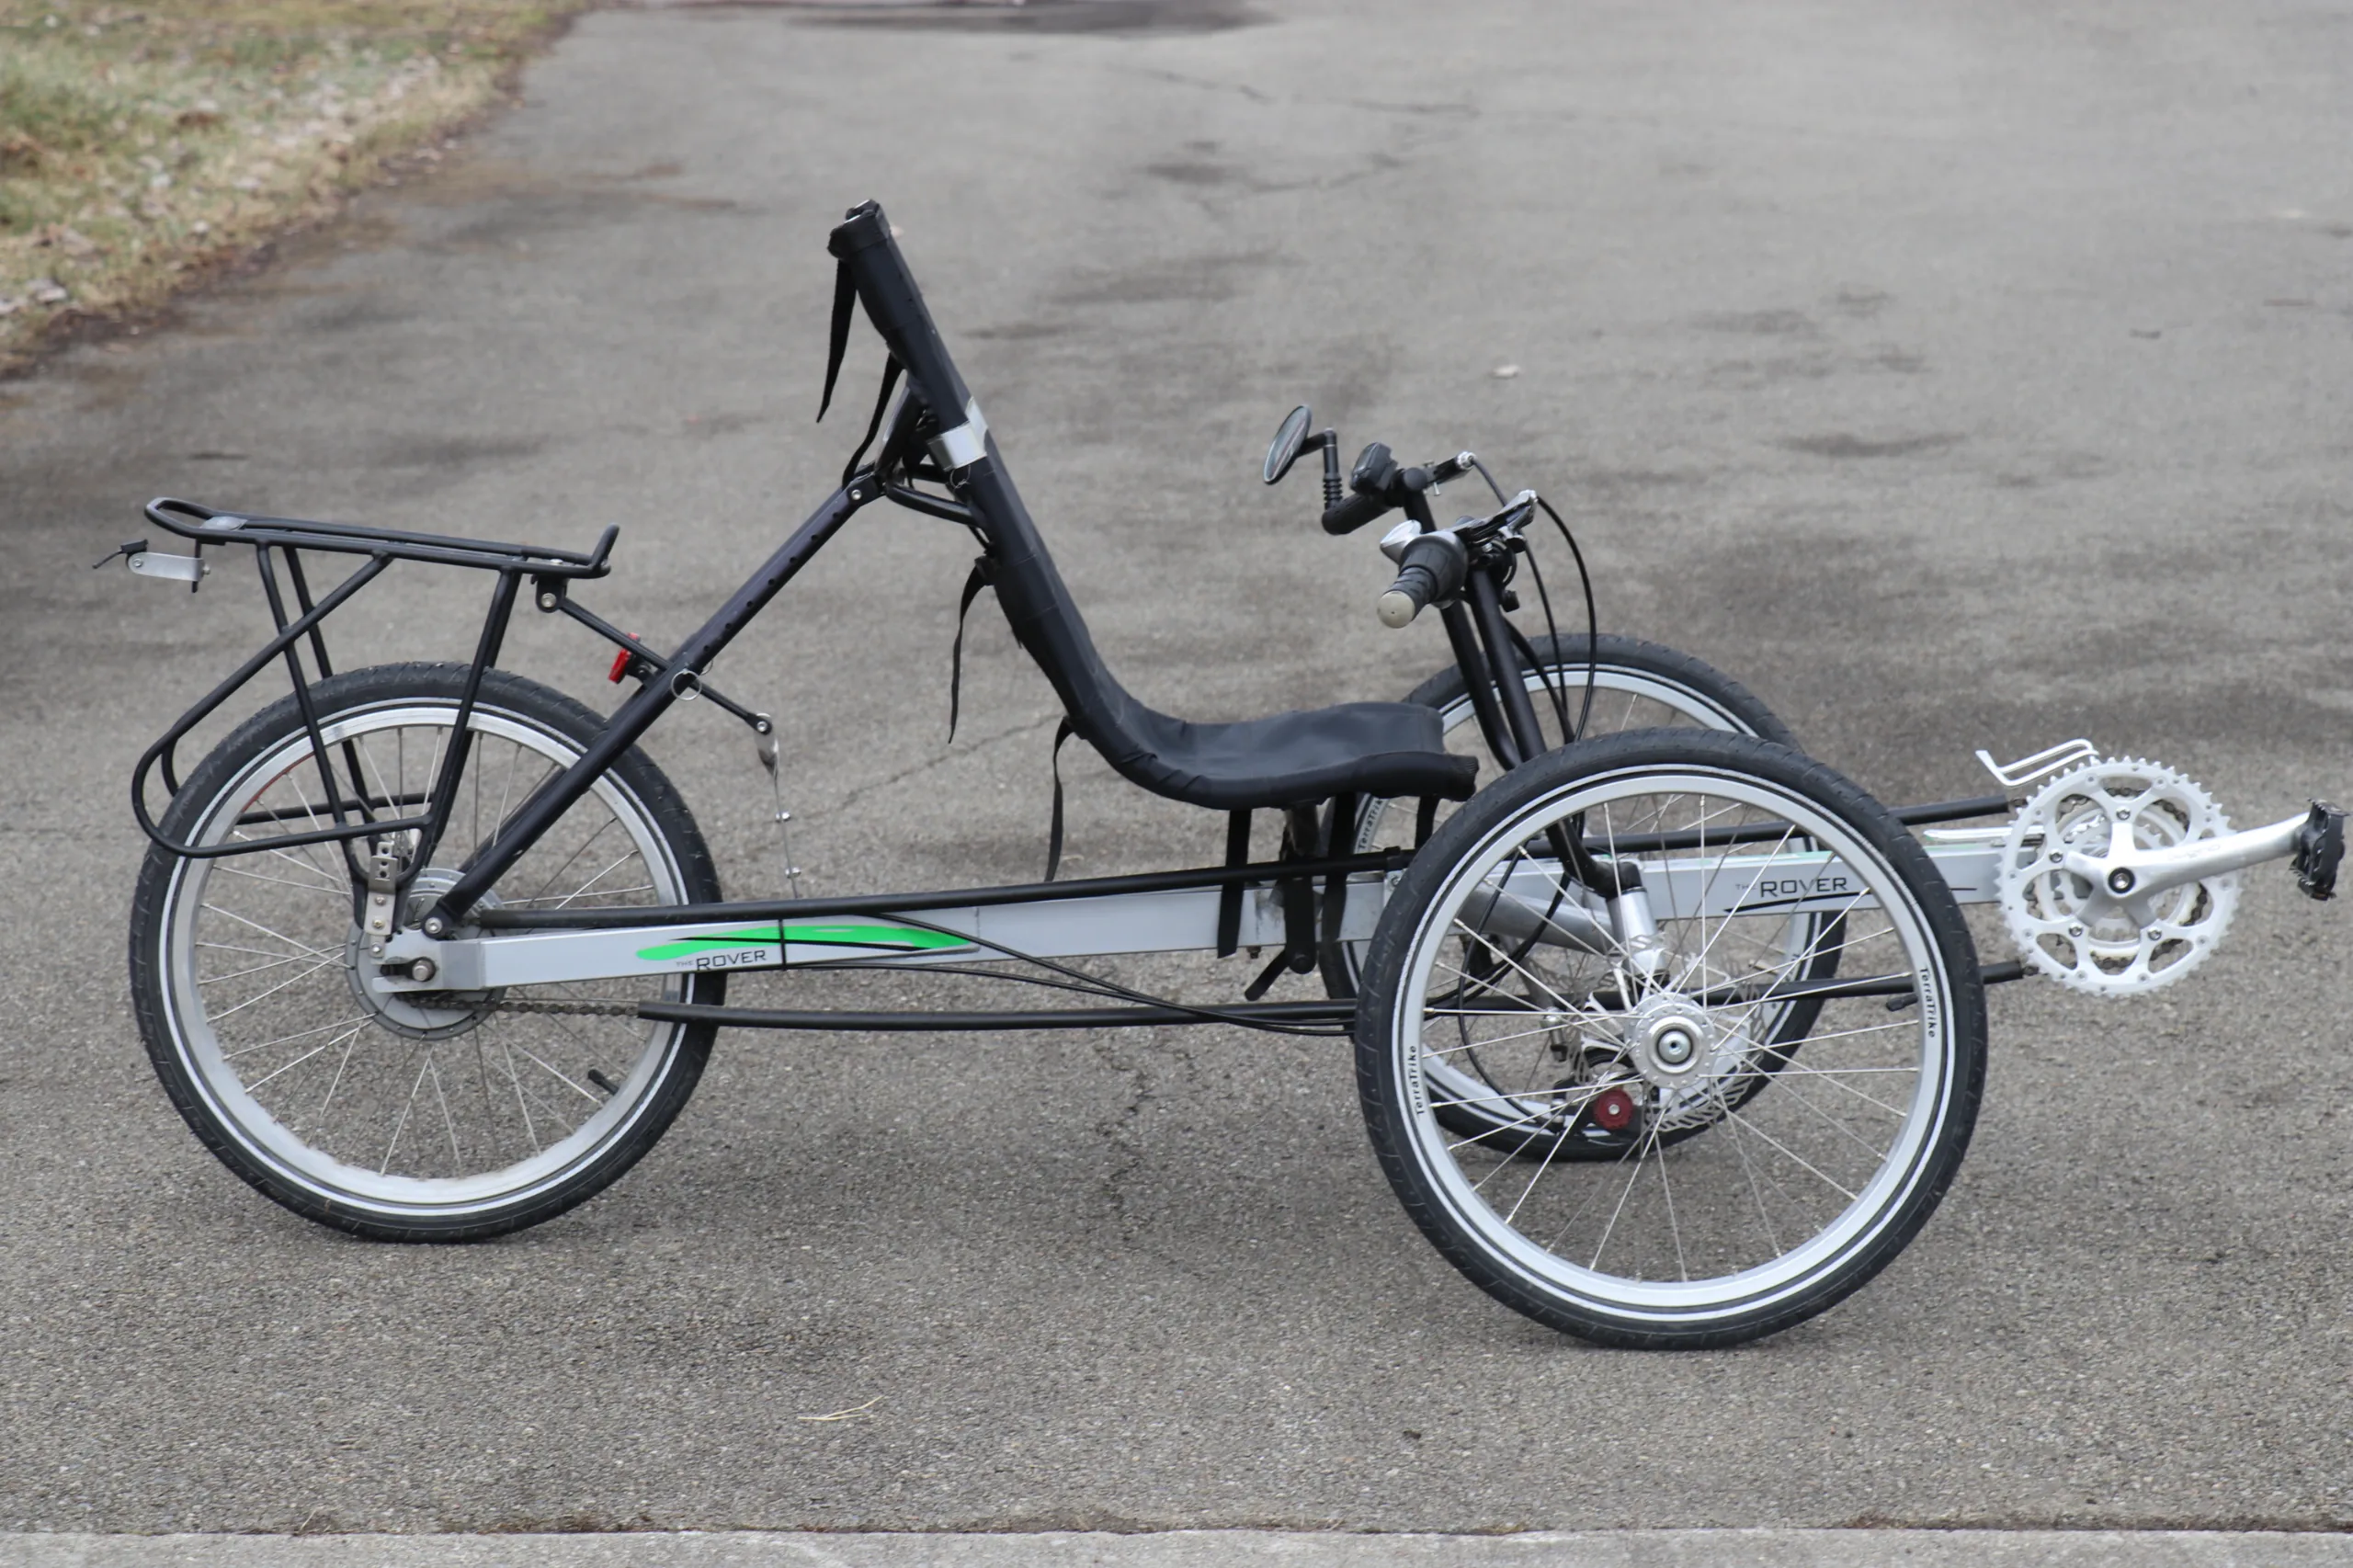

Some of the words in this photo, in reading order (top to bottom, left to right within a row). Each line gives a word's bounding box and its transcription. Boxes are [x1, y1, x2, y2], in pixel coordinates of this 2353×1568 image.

[1358, 799, 1383, 849] TerraTrik
[1760, 877, 1847, 898] ROVER
[696, 949, 767, 971] ROVER
[1919, 966, 1938, 1038] TerraTrike
[1407, 1045, 1426, 1116] TerraTrike
